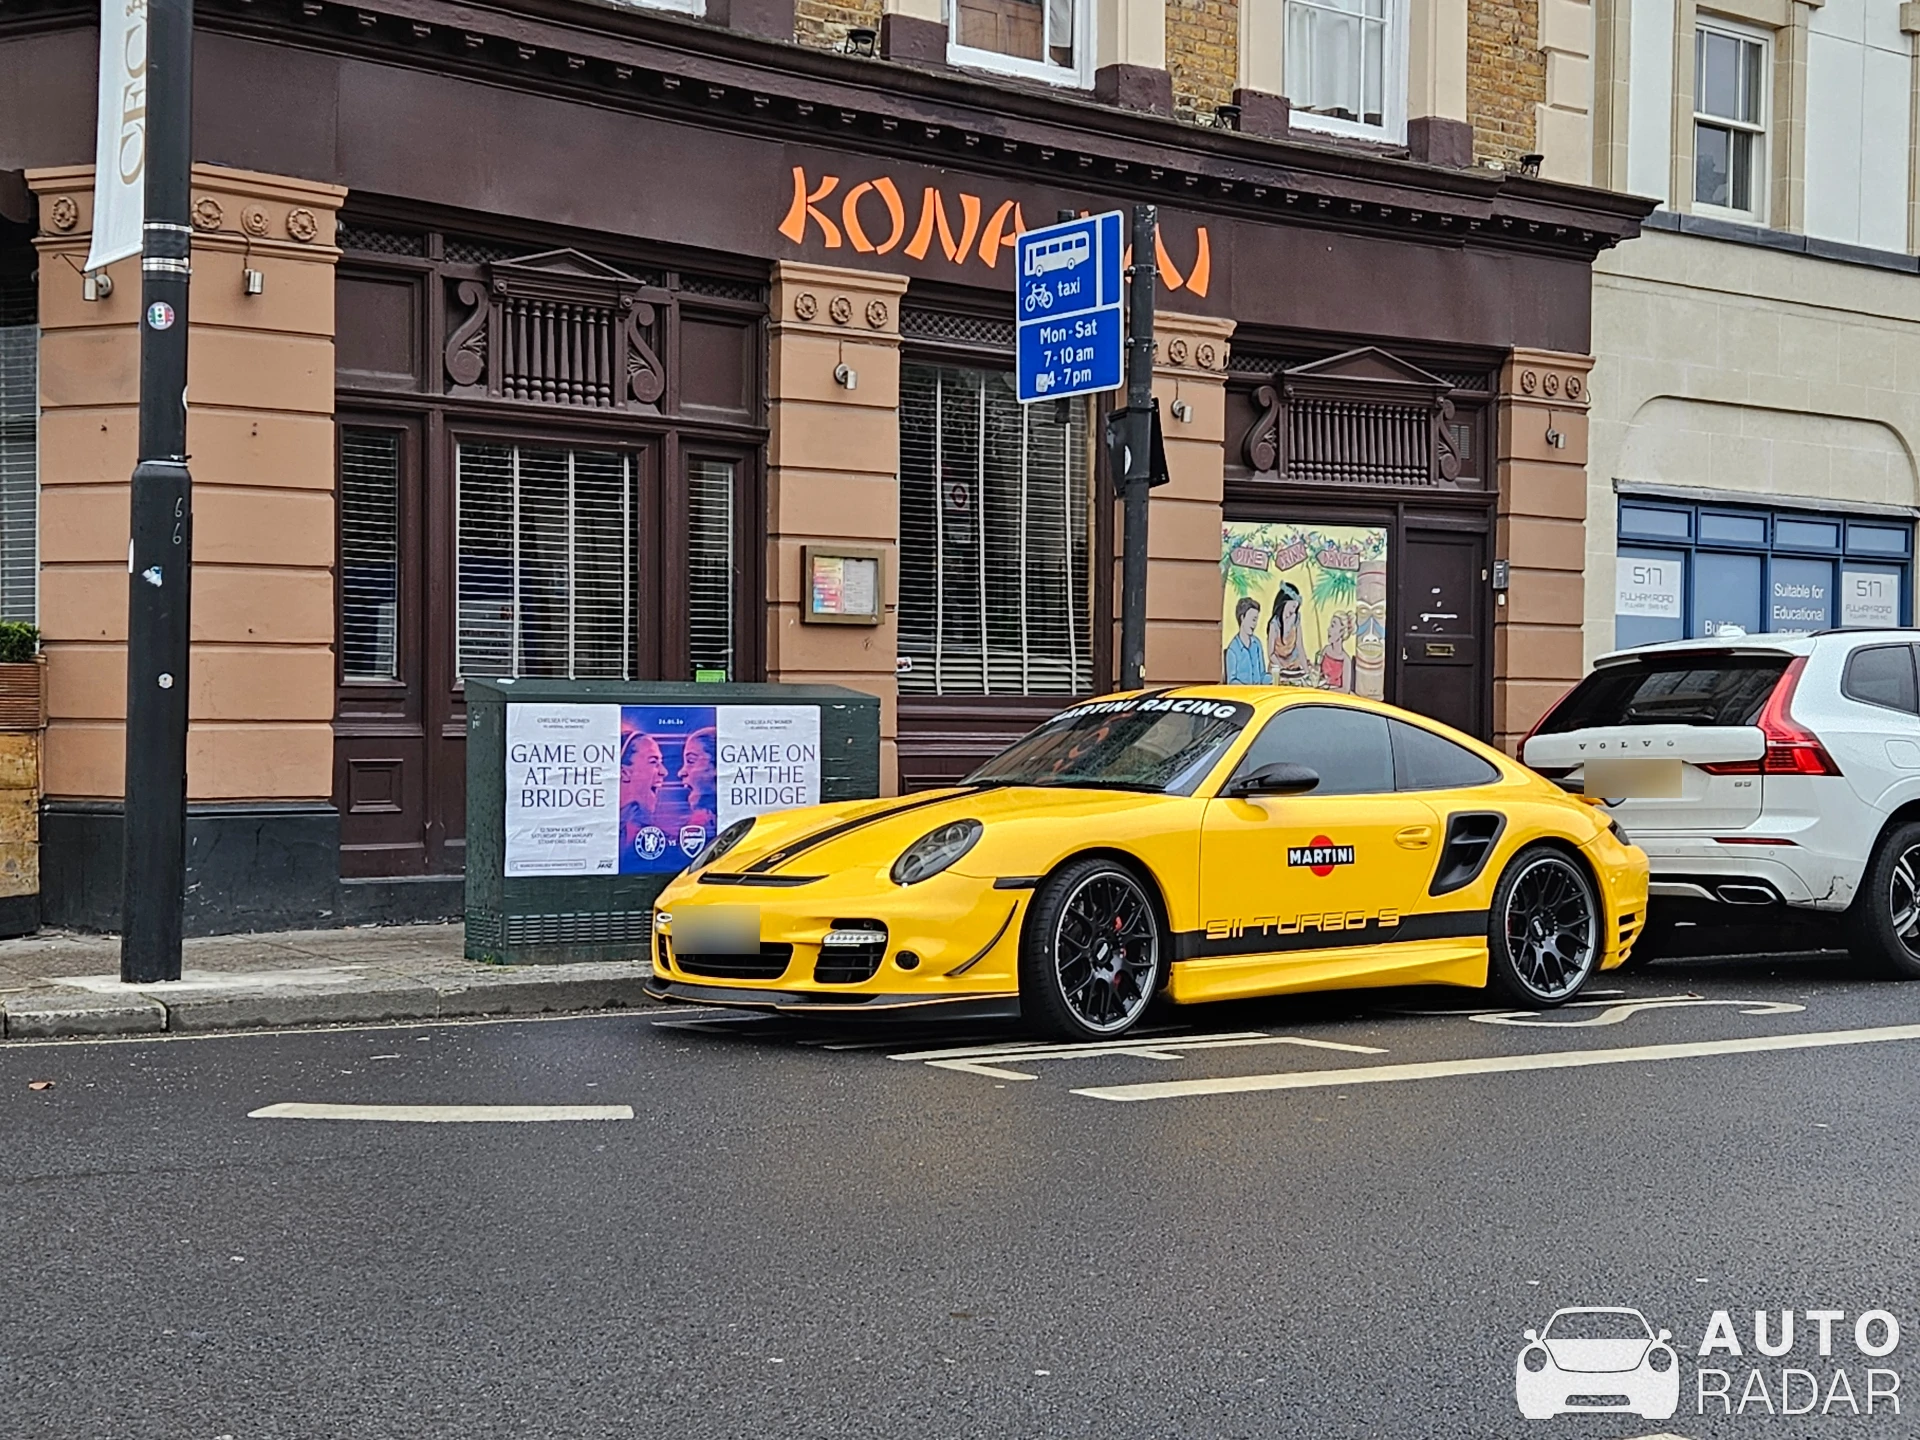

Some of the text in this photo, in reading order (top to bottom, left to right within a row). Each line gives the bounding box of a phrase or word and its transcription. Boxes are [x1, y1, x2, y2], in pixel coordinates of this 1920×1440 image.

[778, 166, 1027, 269] KONA
[1057, 276, 1081, 297] taxi
[1235, 546, 1263, 567] DINE
[1279, 543, 1306, 568] DRINK
[1323, 550, 1356, 568] DANCE
[1633, 566, 1662, 586] 517
[1774, 583, 1825, 599] Suitable for
[1856, 580, 1882, 597] 517
[1773, 605, 1825, 621] Educational
[1137, 700, 1237, 718] RACING
[511, 744, 616, 763] GAME ON
[721, 744, 815, 763] GAME ON
[1578, 740, 1675, 751] VOLVO
[524, 767, 603, 785] AT THE
[733, 766, 804, 784] AT THE
[521, 788, 605, 808] BRIDGE
[731, 786, 807, 805] BRIDGE
[1289, 848, 1353, 865] MARTINI
[1206, 907, 1400, 940] 911 TURBO S
